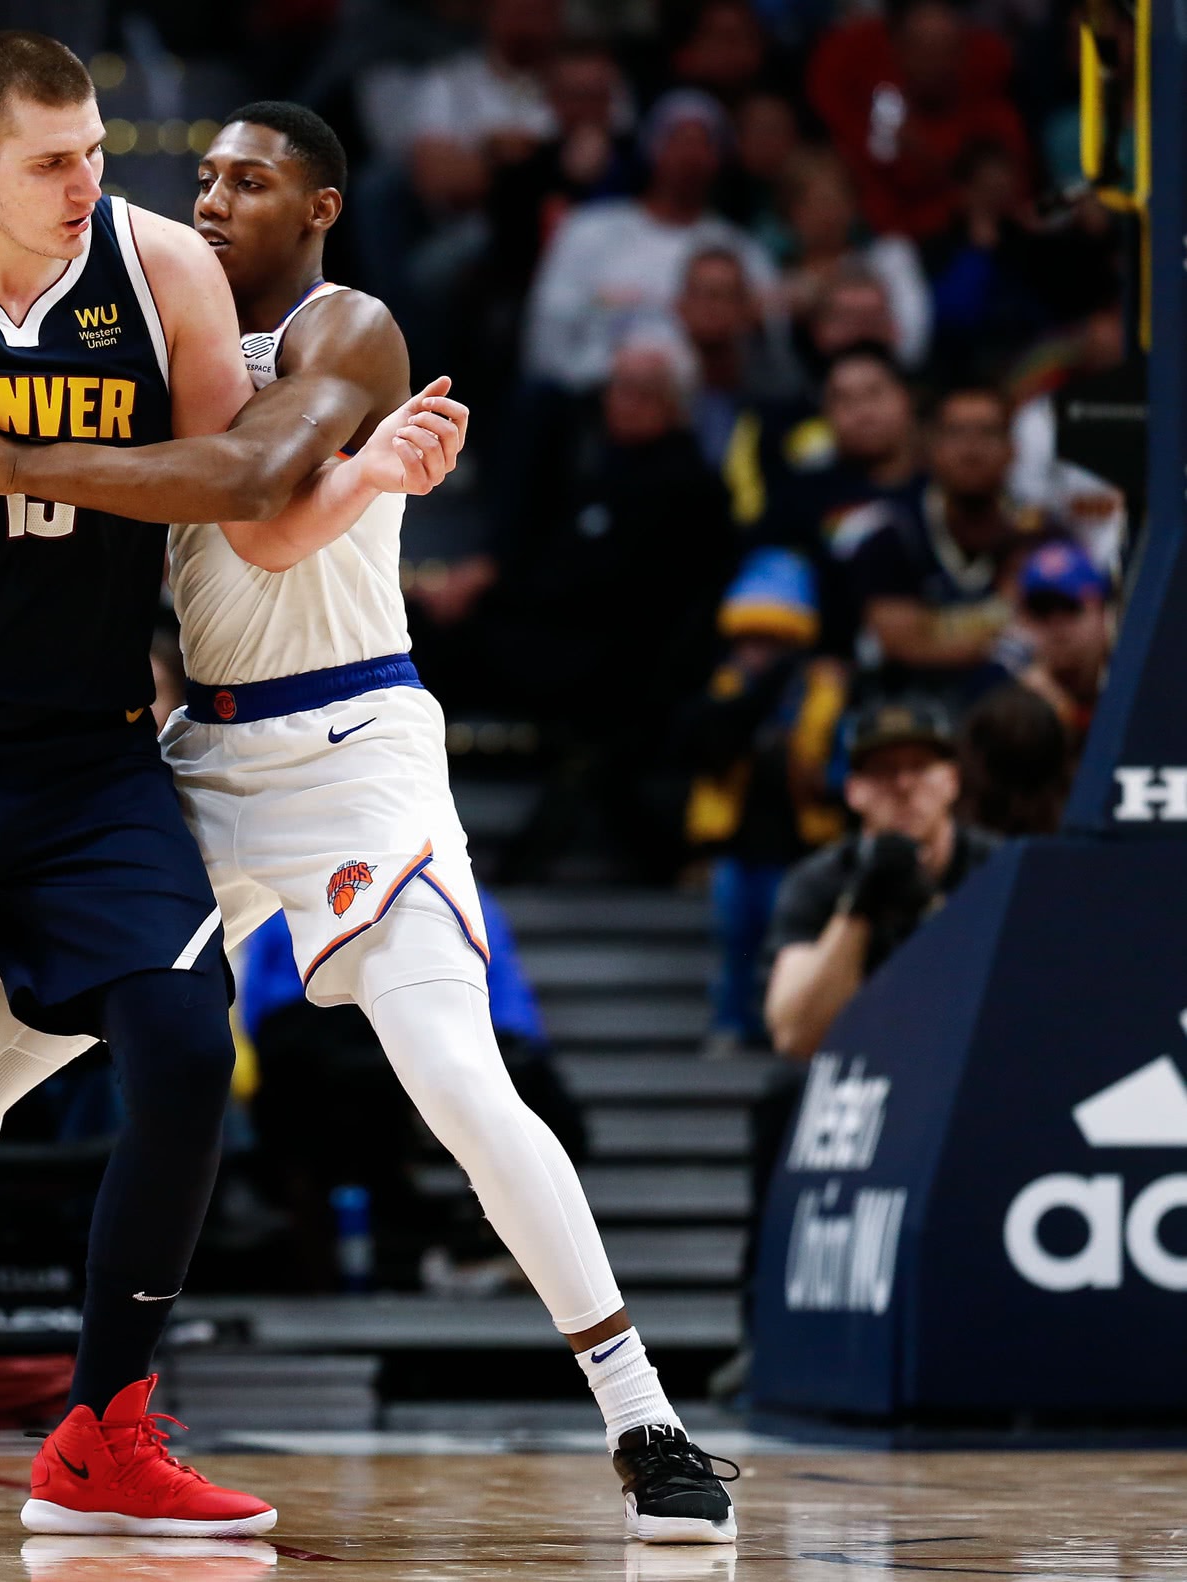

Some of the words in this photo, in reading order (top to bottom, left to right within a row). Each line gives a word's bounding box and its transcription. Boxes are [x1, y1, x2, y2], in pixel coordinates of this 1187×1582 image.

[74, 303, 118, 328] WU
[78, 326, 122, 341] Western
[87, 337, 117, 349] Union
[245, 363, 272, 373] ESPACE
